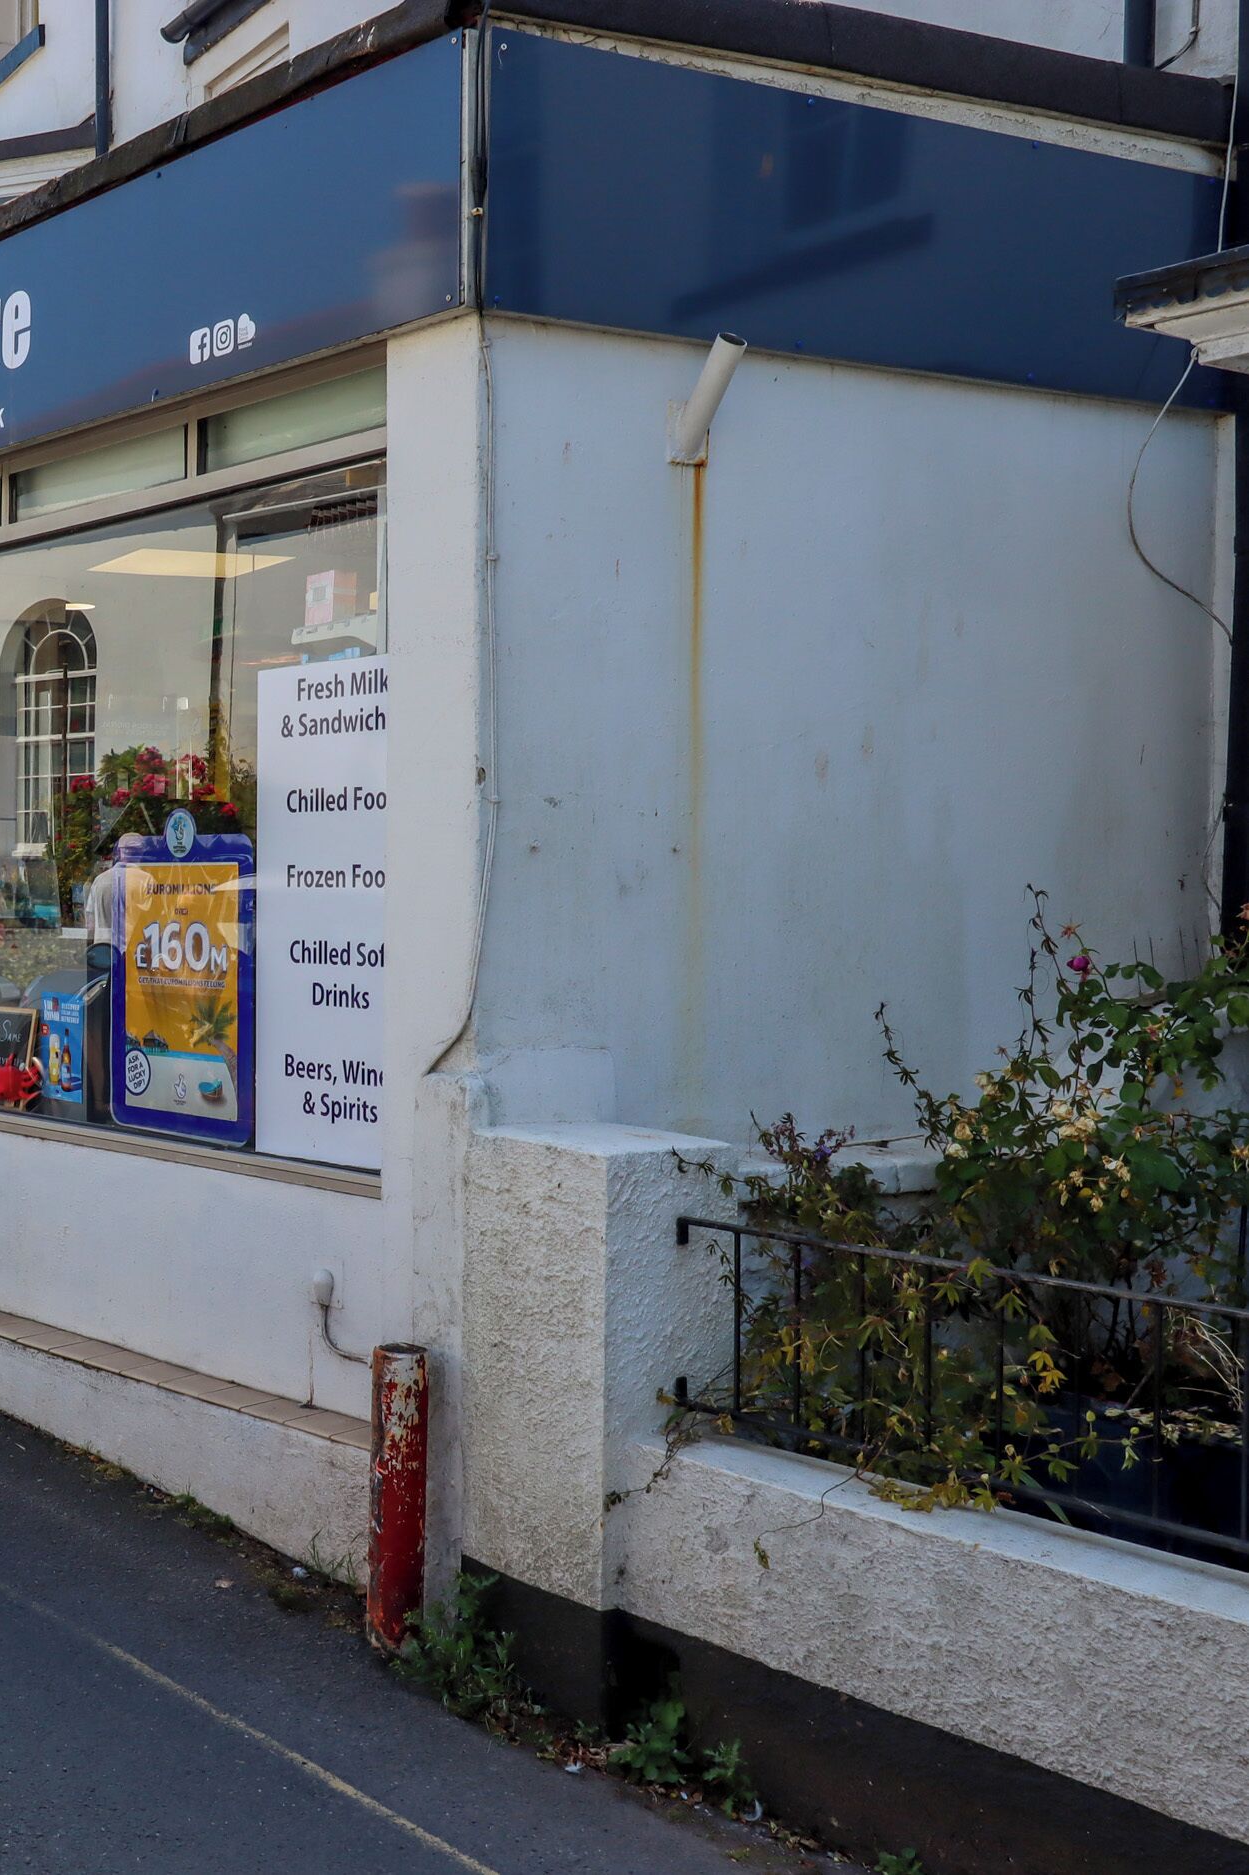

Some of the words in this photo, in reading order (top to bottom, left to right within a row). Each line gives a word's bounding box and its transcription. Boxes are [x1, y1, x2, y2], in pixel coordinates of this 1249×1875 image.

[297, 673, 345, 702] Fresh
[351, 668, 388, 697] Milk
[281, 714, 294, 739] &
[298, 705, 386, 738] Sandwich
[286, 786, 348, 813] Chilled
[353, 786, 387, 811] Foo
[147, 884, 216, 895] EUROMILLIONS
[287, 864, 346, 888] Frozen
[352, 864, 386, 888] Foo
[135, 921, 227, 973] £160M
[290, 940, 351, 966] Chilled
[312, 982, 370, 1009] Drinks
[128, 1054, 139, 1065] ASK
[128, 1064, 139, 1074] FOR
[284, 1053, 337, 1086] Beers,
[128, 1069, 146, 1083] LUCKY
[303, 1091, 315, 1115] &
[320, 1093, 378, 1124] Spirits
